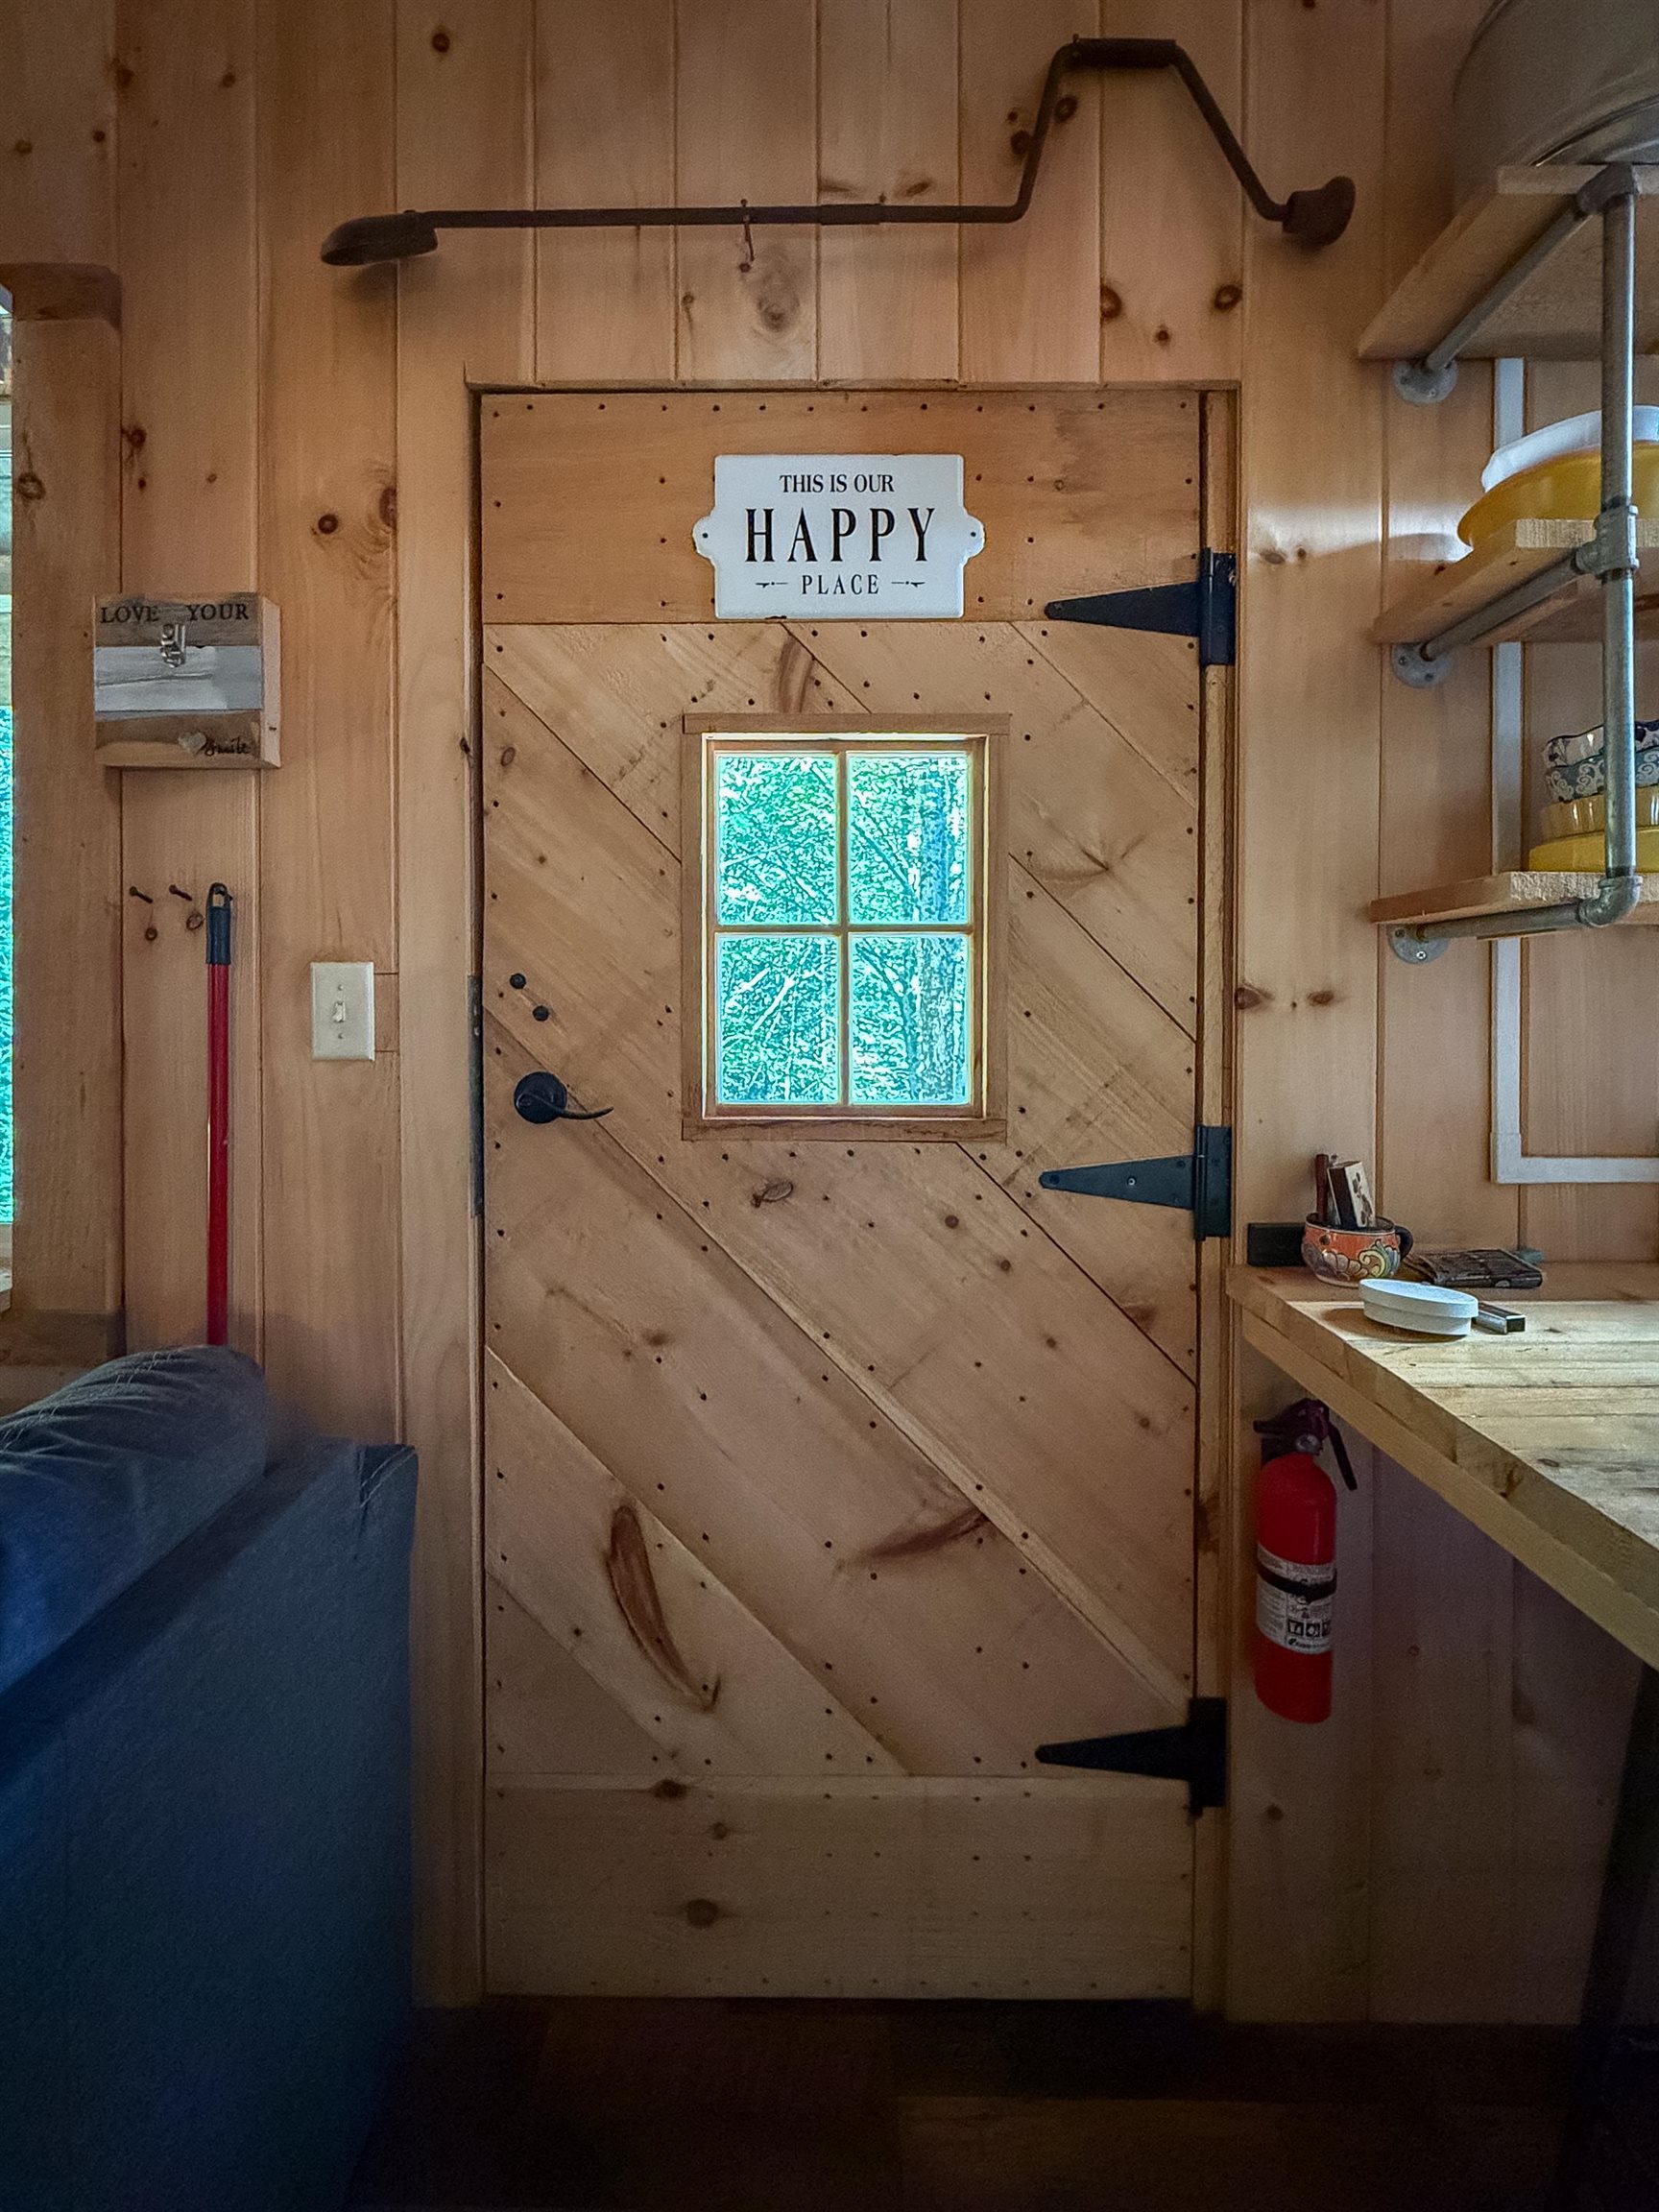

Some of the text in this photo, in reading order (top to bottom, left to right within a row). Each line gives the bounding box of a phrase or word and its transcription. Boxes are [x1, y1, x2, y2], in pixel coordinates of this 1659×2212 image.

[779, 473, 895, 493] THIS IS OUR
[744, 507, 935, 563] HAPPY
[802, 574, 879, 595] PLACE
[100, 604, 250, 624] LOVE YOUR
